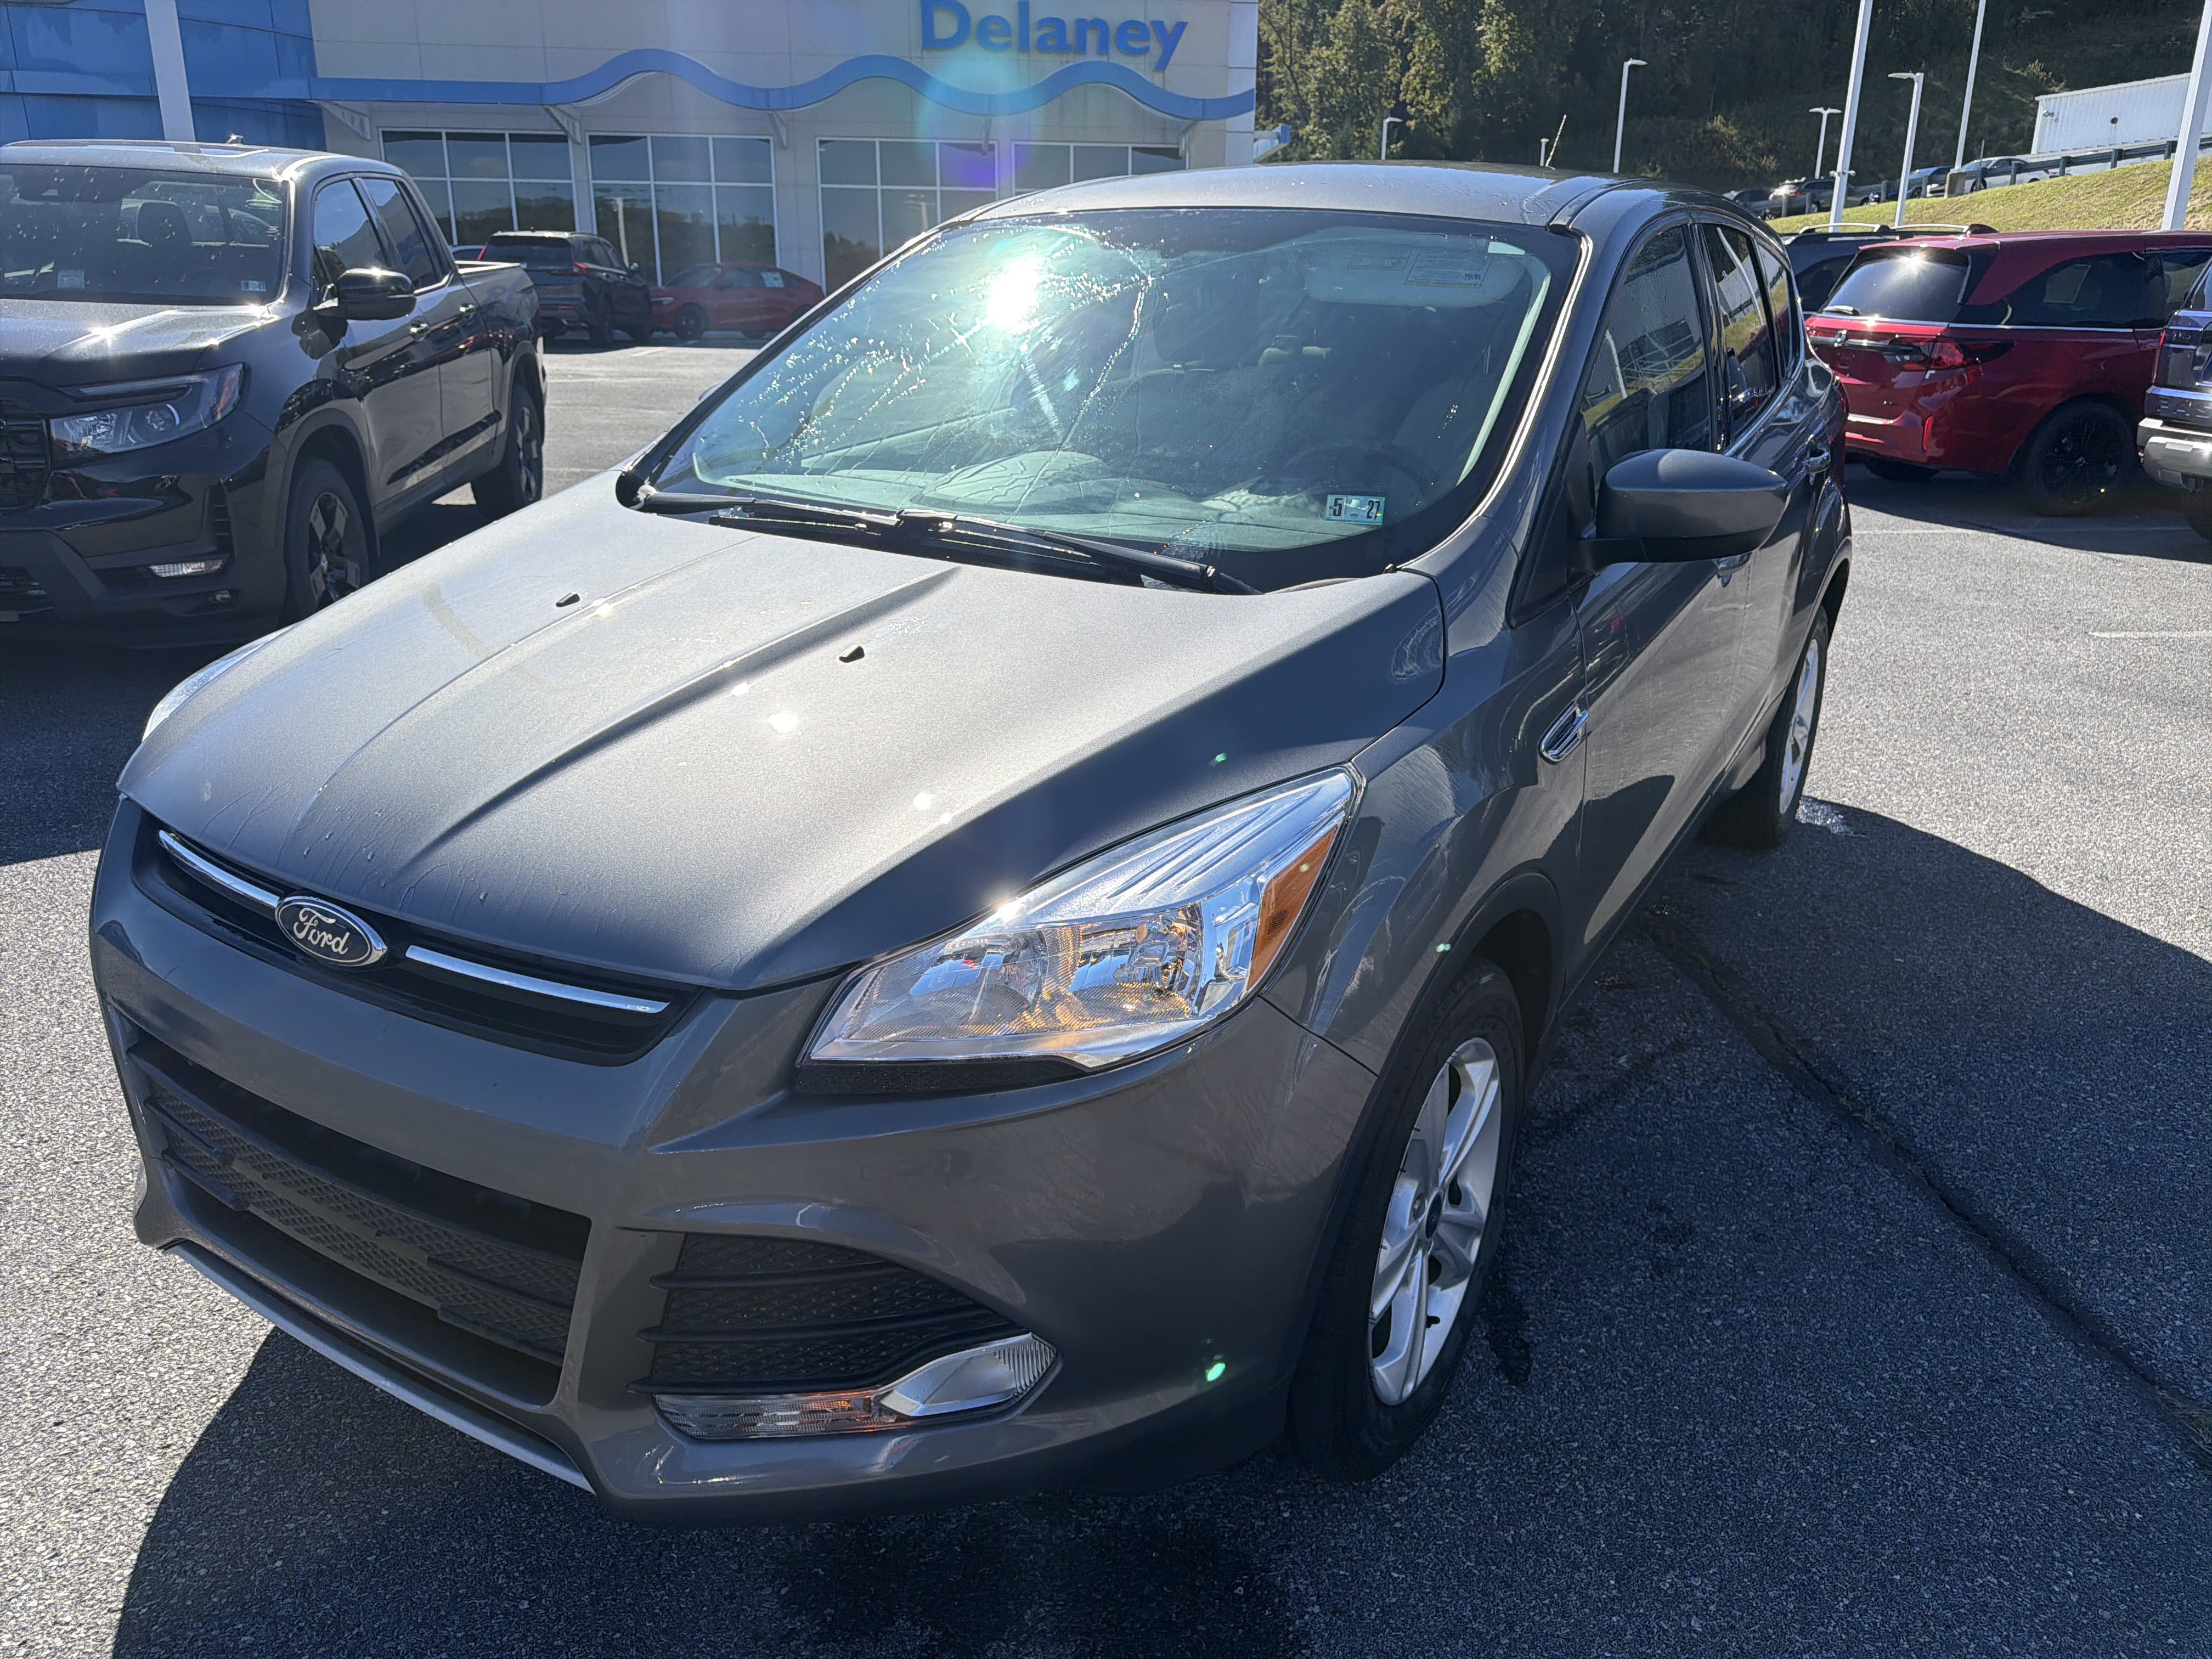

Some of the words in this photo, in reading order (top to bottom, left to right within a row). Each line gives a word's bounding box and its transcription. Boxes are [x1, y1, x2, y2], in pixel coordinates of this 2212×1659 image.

[921, 0, 1189, 71] Delaney
[1332, 498, 1344, 517] 5
[1366, 500, 1381, 520] 27
[293, 907, 351, 955] Ford
